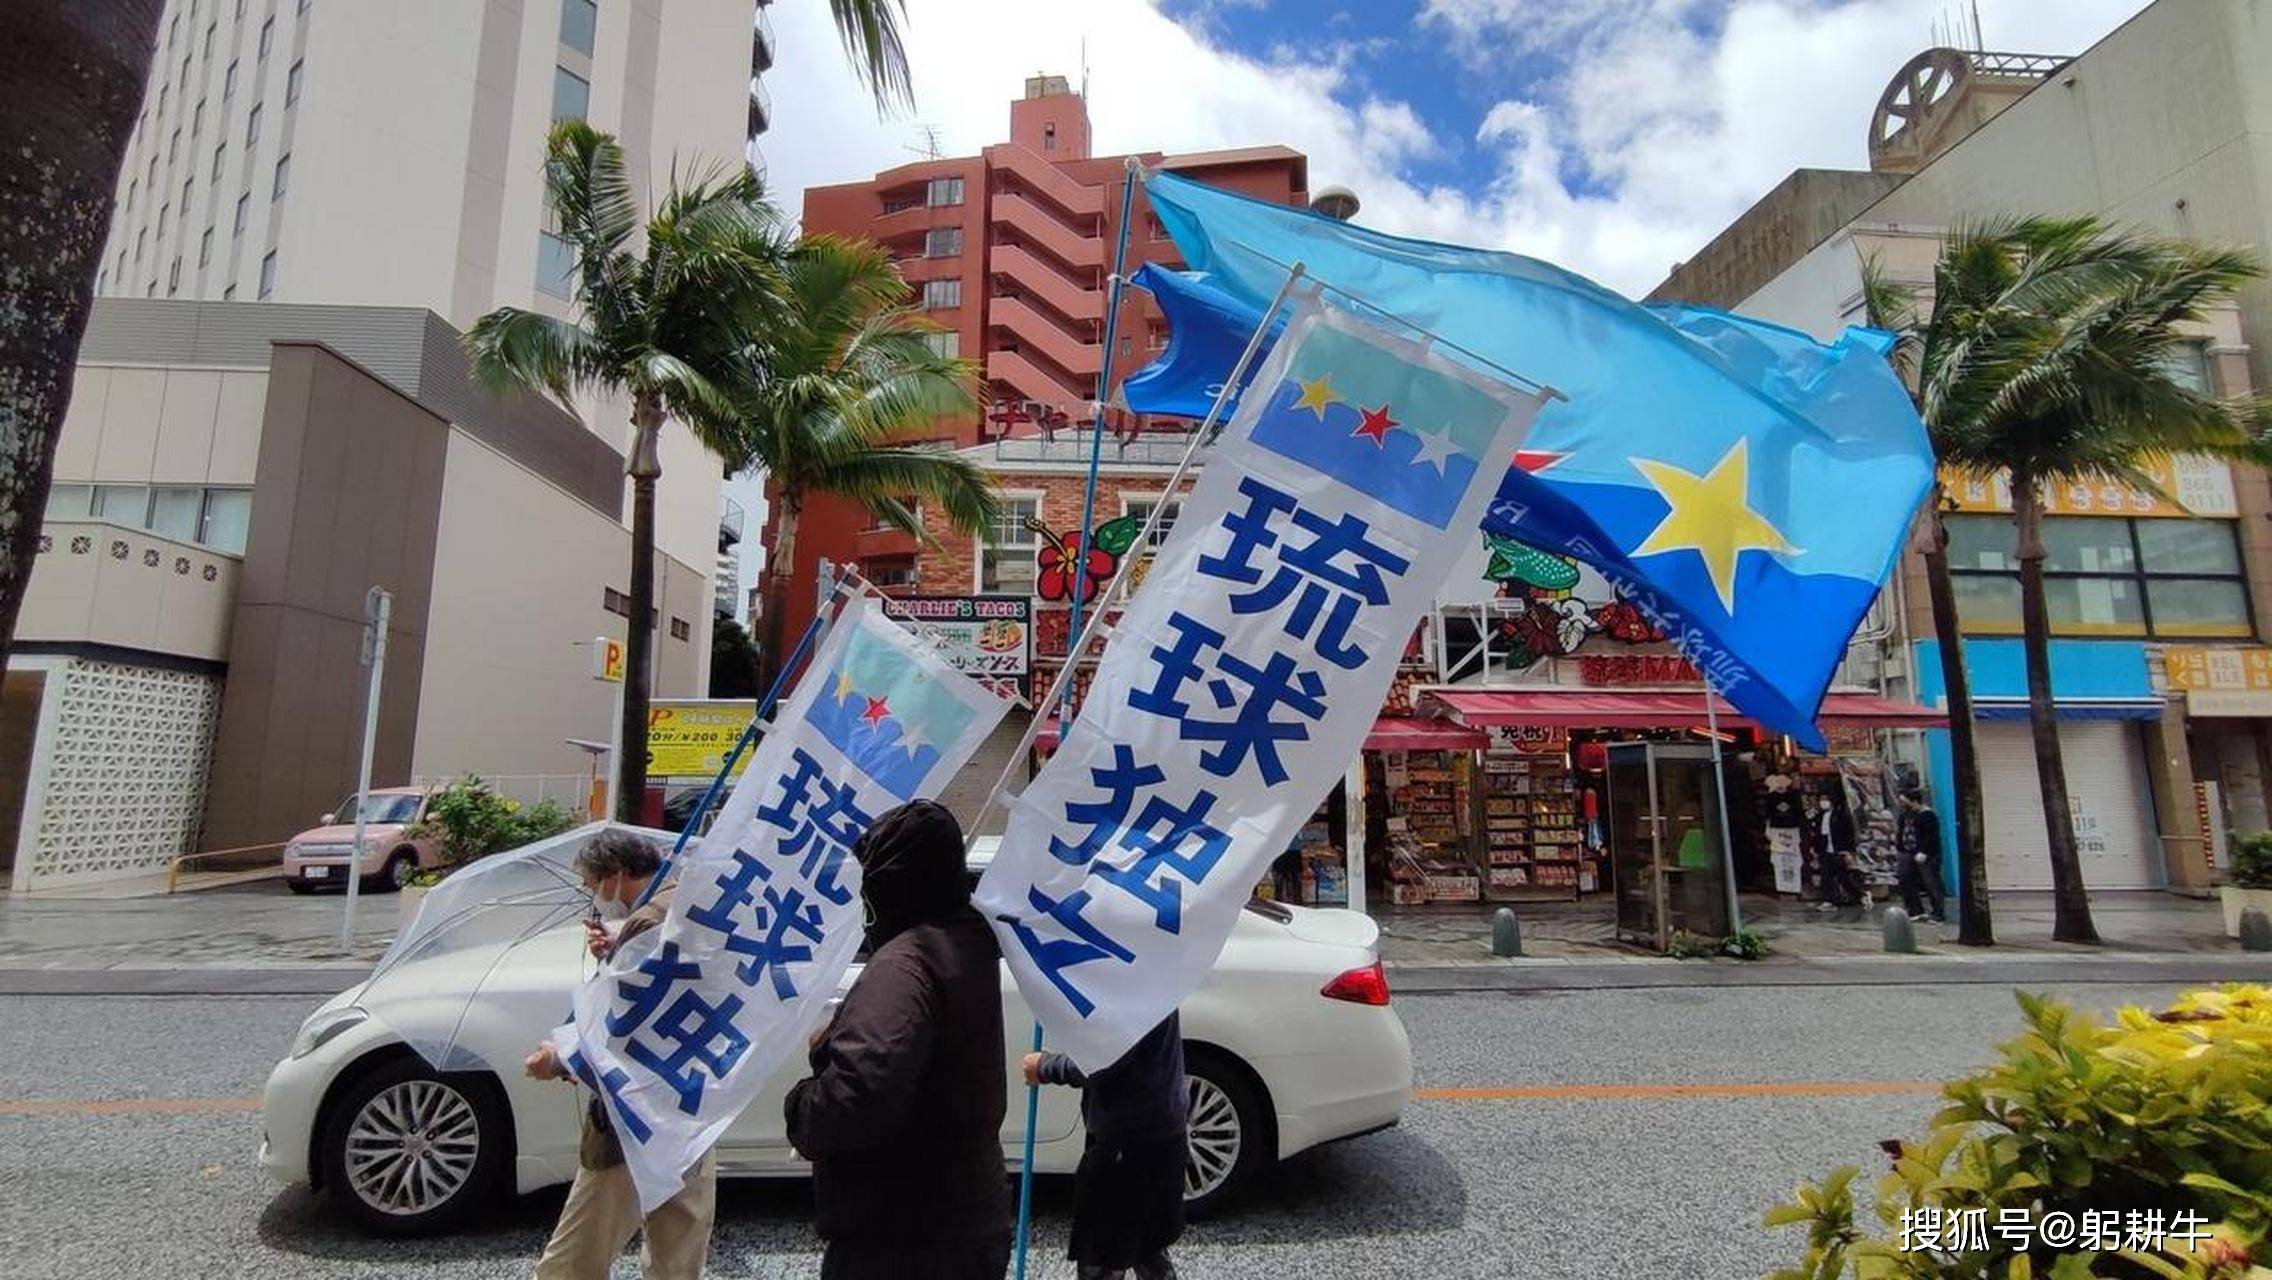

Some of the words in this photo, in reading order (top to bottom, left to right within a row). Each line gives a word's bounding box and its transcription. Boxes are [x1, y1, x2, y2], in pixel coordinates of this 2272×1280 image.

[887, 600, 972, 617] CHARLIE'S
[975, 601, 1025, 617] TACOS
[606, 641, 620, 676] P
[648, 708, 673, 727] P
